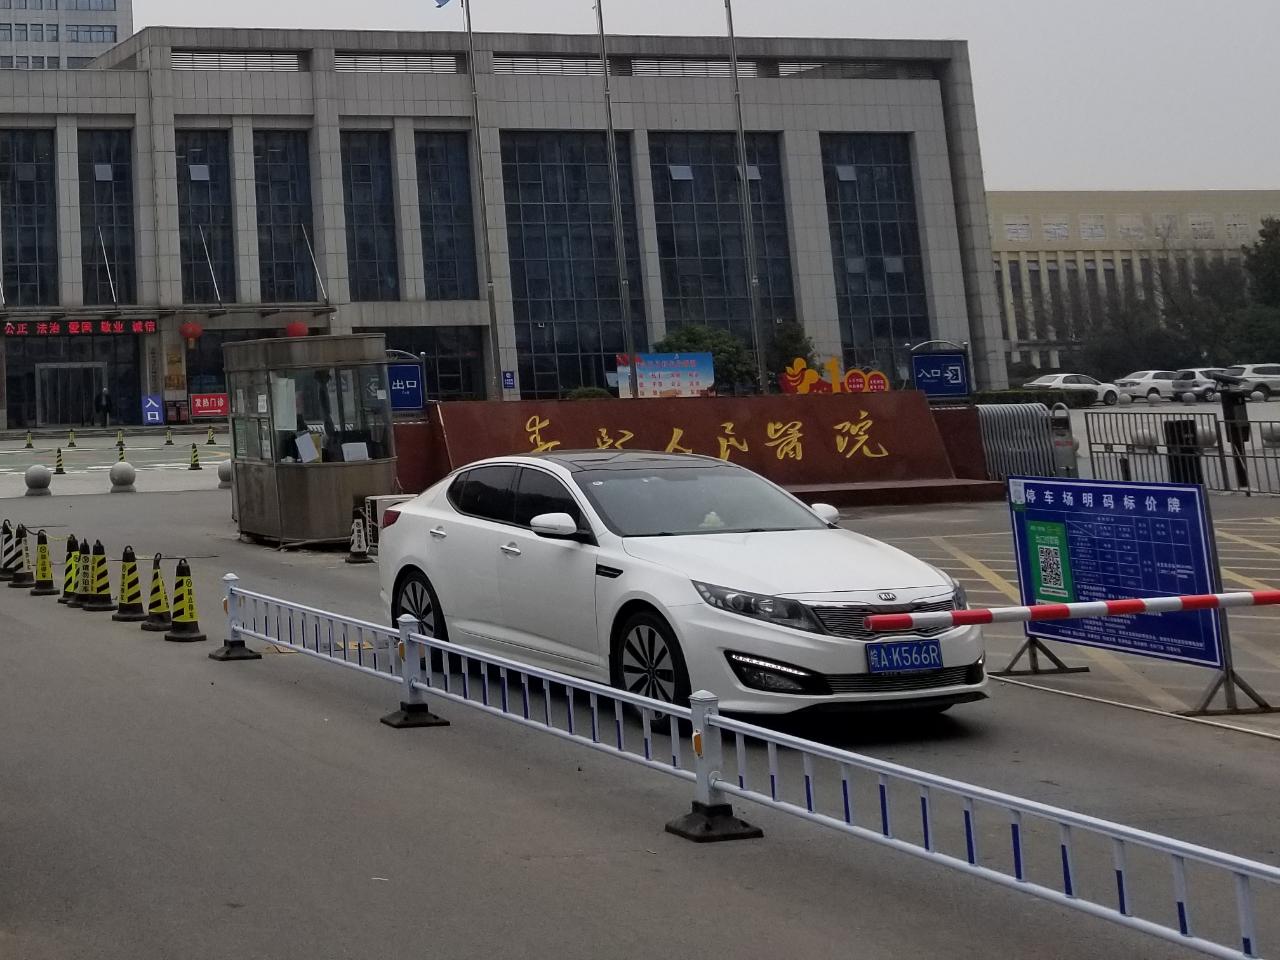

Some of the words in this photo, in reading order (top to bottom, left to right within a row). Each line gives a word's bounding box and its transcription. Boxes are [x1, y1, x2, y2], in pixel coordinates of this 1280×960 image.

[917, 368, 941, 378] 入口
[391, 379, 417, 390] 出口
[145, 398, 159, 421] 入口
[1025, 489, 1182, 513] 停车场明码标价牌
